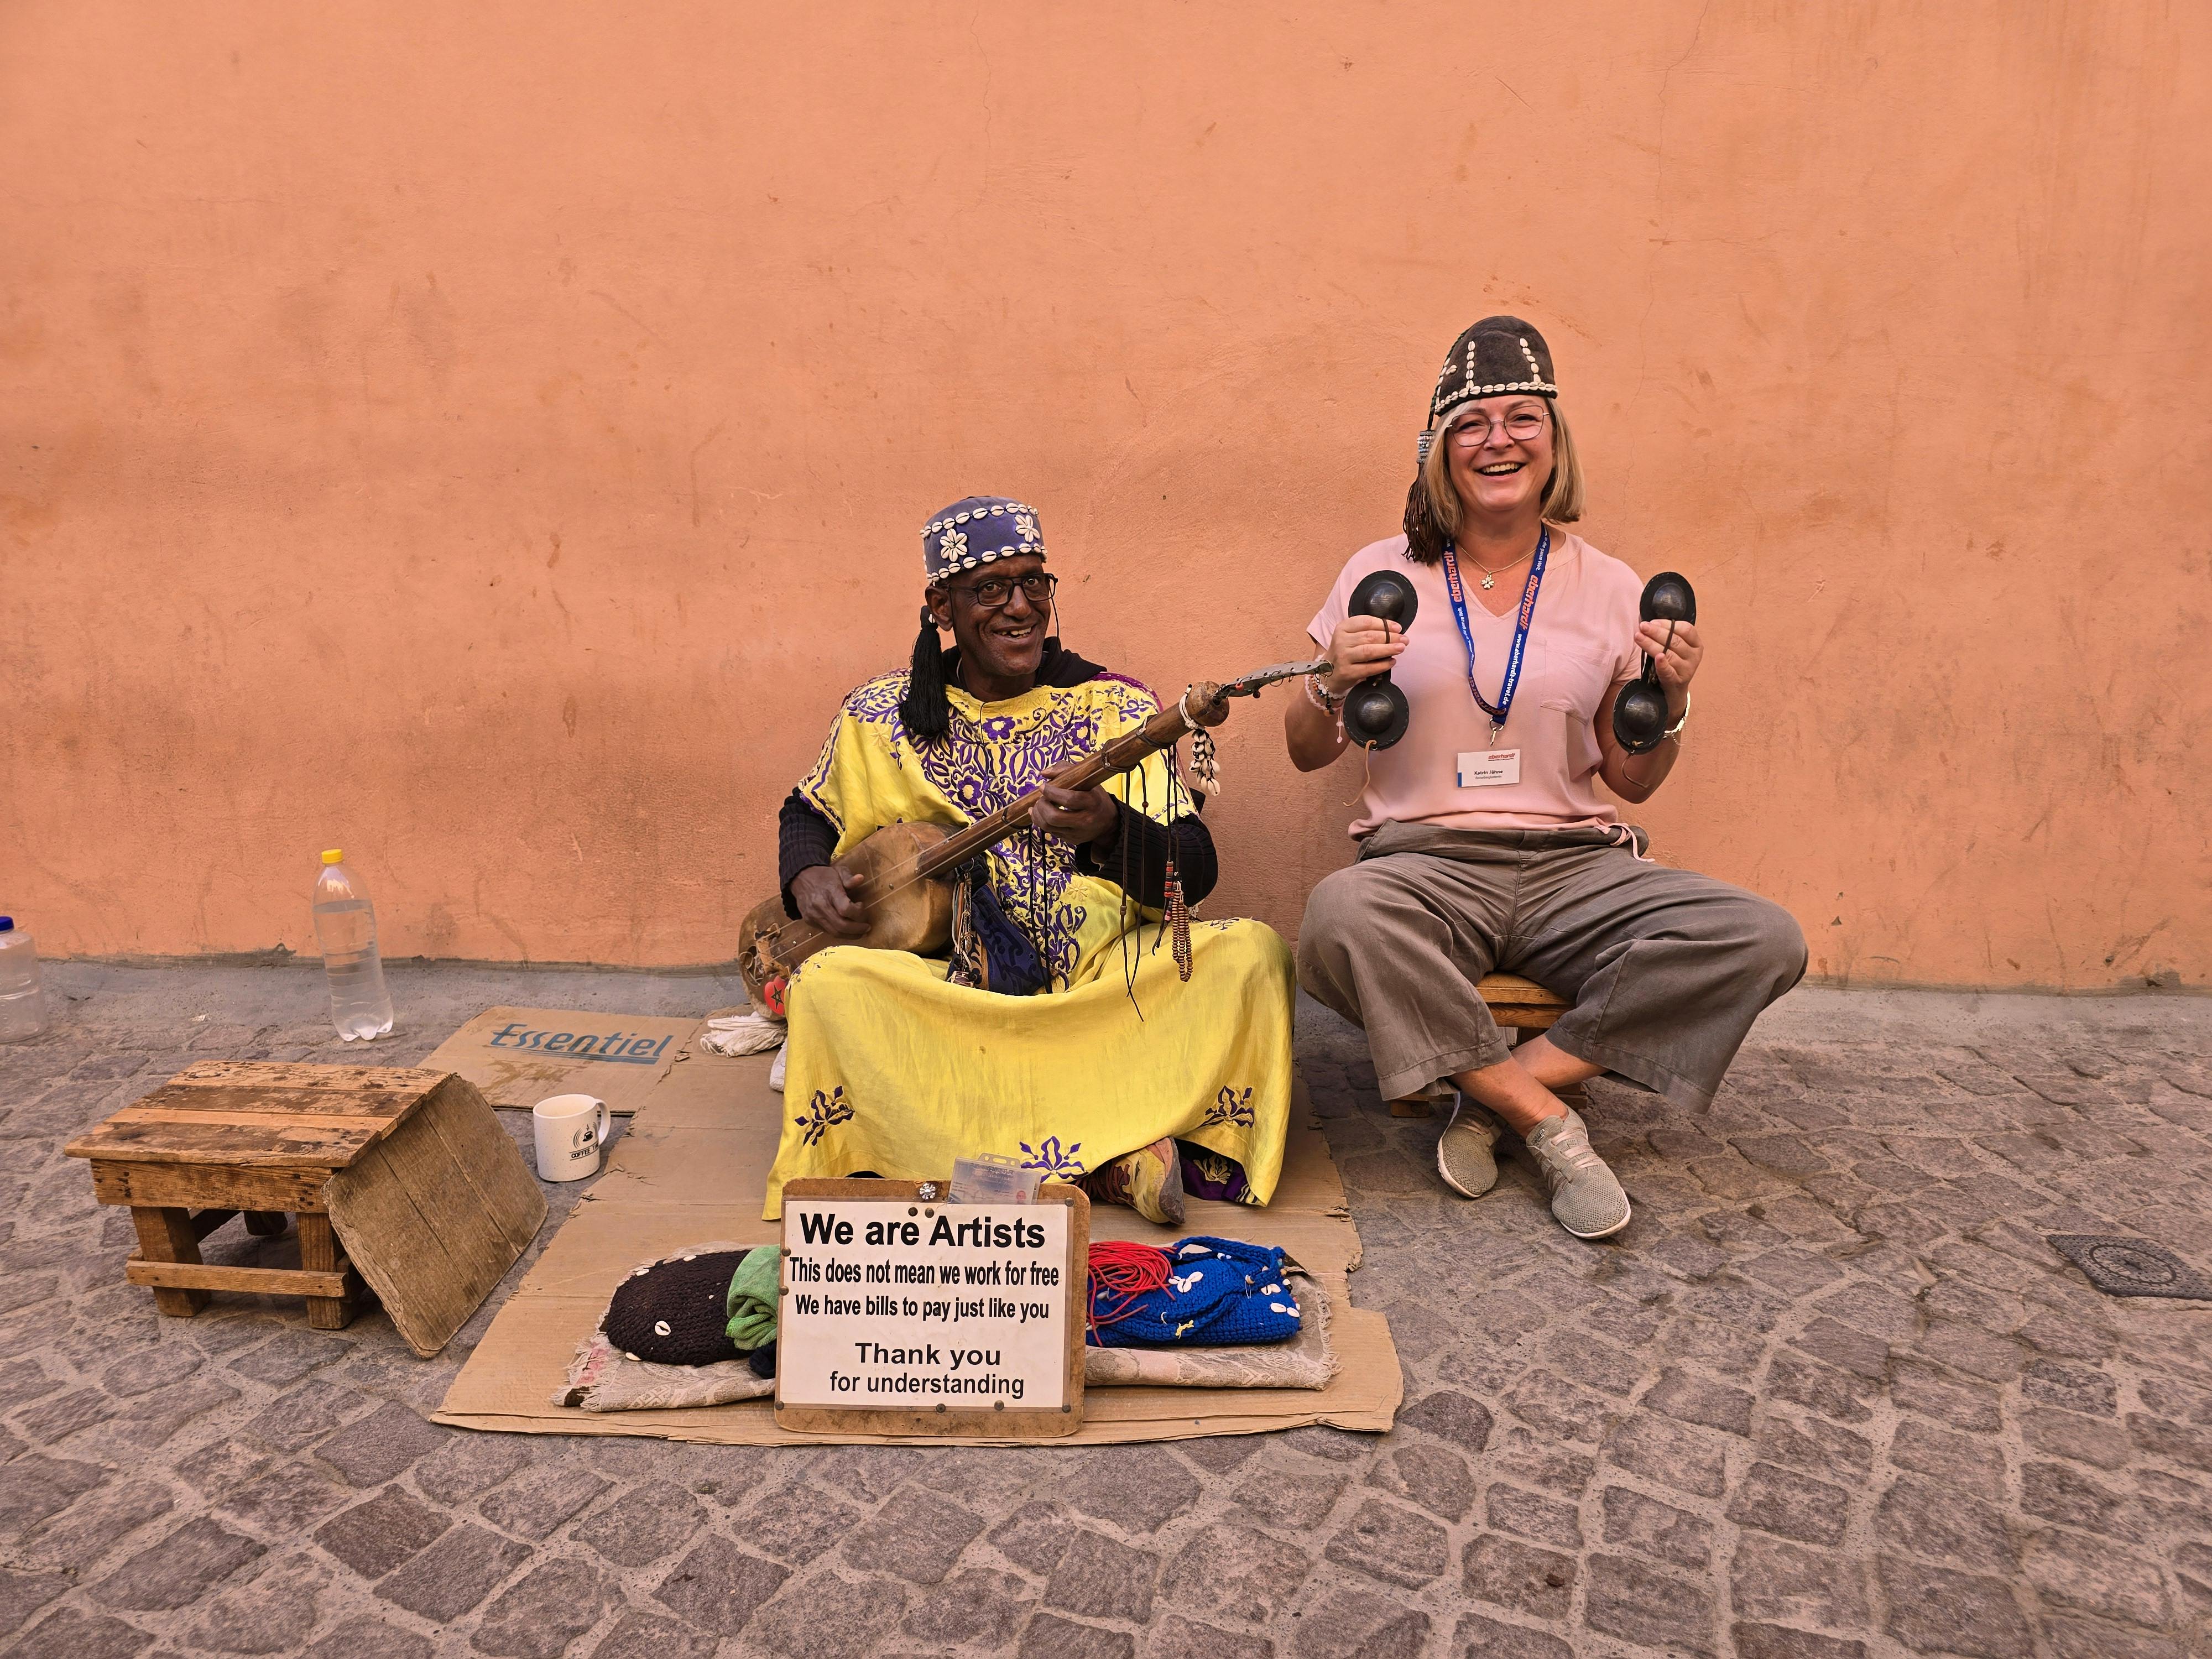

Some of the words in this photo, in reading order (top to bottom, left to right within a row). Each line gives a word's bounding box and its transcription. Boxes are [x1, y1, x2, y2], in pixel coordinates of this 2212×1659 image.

[1444, 551, 1462, 602] eberhardt
[1520, 575, 1538, 630] eberhardt
[1503, 634, 1522, 705] www.eberhardt-travel.de
[491, 1024, 674, 1057] Essentiel
[571, 1148, 591, 1159] COFFEE
[800, 1213, 853, 1244] We
[865, 1222, 919, 1245] are
[928, 1215, 1045, 1248] Artists
[790, 1257, 820, 1282] This
[826, 1258, 861, 1282] does
[867, 1259, 890, 1283] not
[895, 1265, 935, 1284] mean
[940, 1265, 960, 1284] we
[964, 1261, 1001, 1285] work
[1005, 1260, 1026, 1285] for
[1030, 1261, 1058, 1286] free
[796, 1295, 819, 1314] We
[825, 1295, 860, 1315] have
[866, 1296, 898, 1316] bills
[903, 1296, 917, 1316] to
[923, 1302, 951, 1322] pay
[954, 1297, 984, 1322] just
[989, 1298, 1015, 1318] like
[1020, 1303, 1048, 1323] you
[855, 1343, 940, 1364] Thank
[950, 1350, 1000, 1370] you
[830, 1371, 860, 1391] for
[868, 1373, 1024, 1399] understanding
